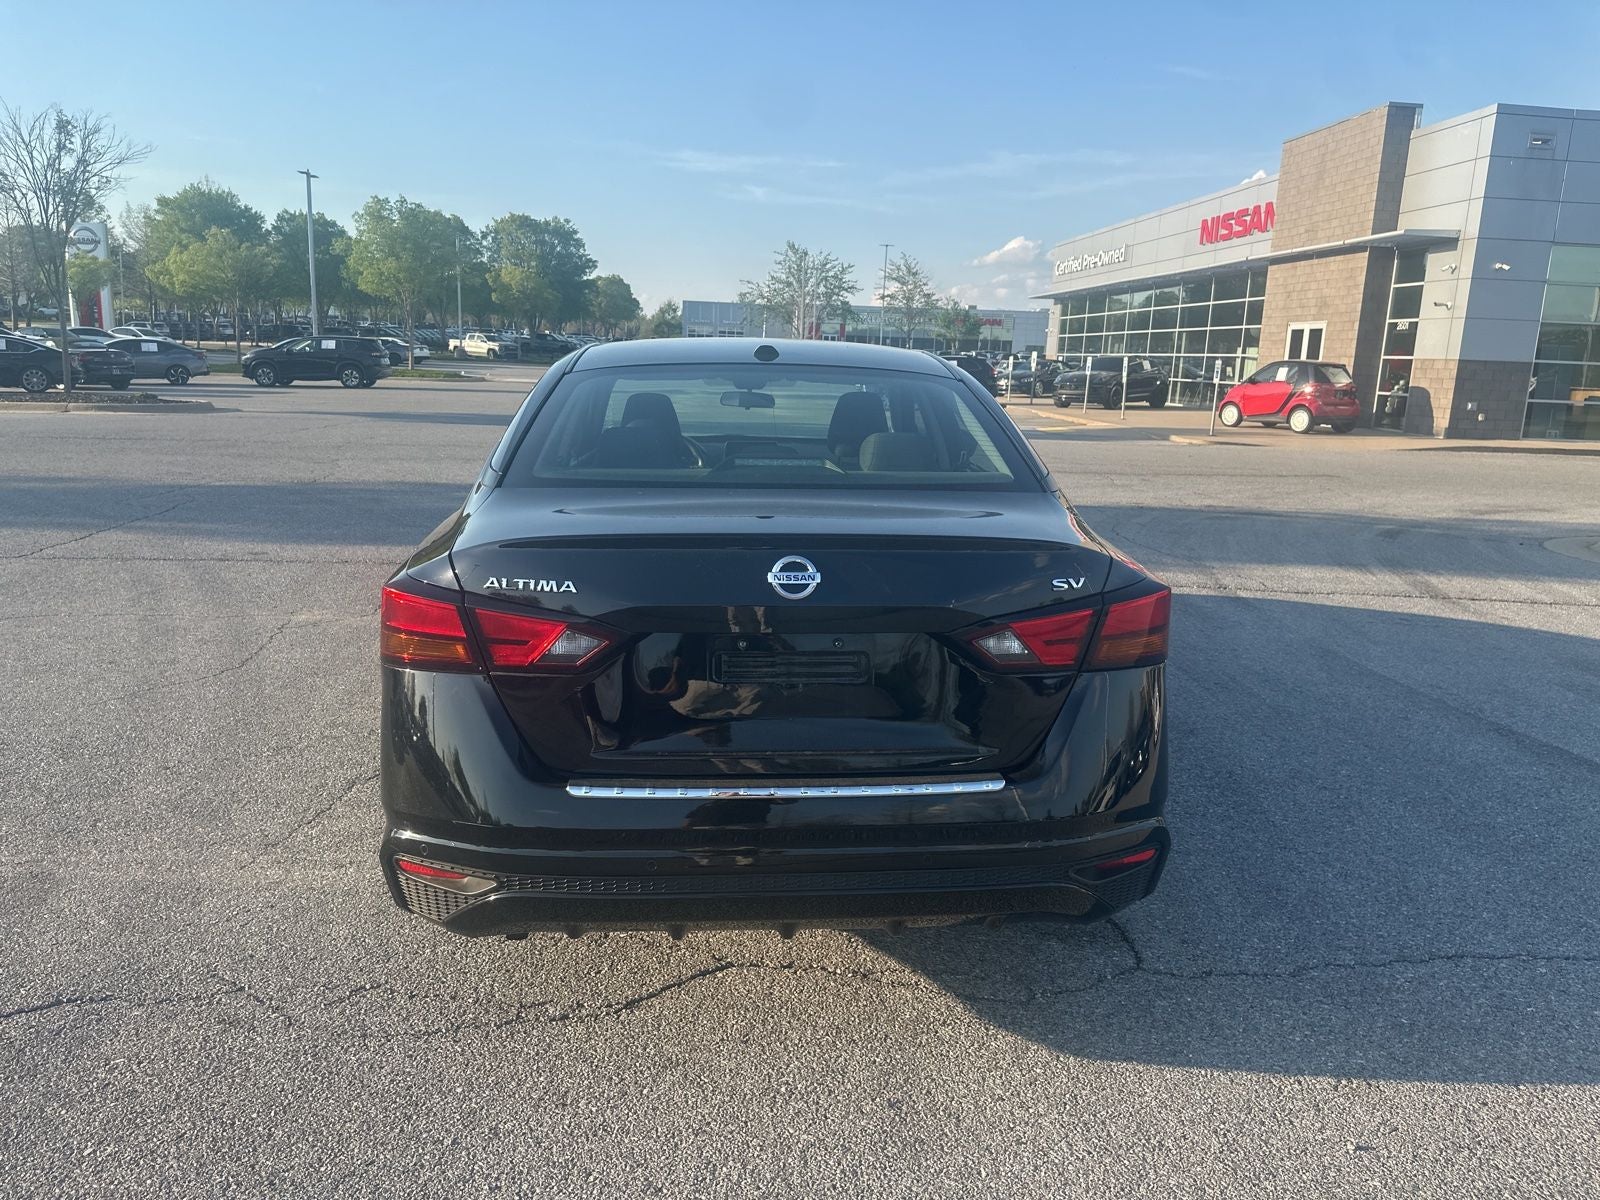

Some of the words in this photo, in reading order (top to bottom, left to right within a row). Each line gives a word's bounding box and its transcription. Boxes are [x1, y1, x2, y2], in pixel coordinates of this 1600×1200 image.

[1199, 201, 1276, 246] NISSAN
[1055, 255, 1082, 276] Certified
[1082, 242, 1127, 270] Pre-Owned
[483, 576, 578, 593] ALTIMA
[773, 574, 816, 582] NISSAN
[1051, 577, 1086, 591] SV
